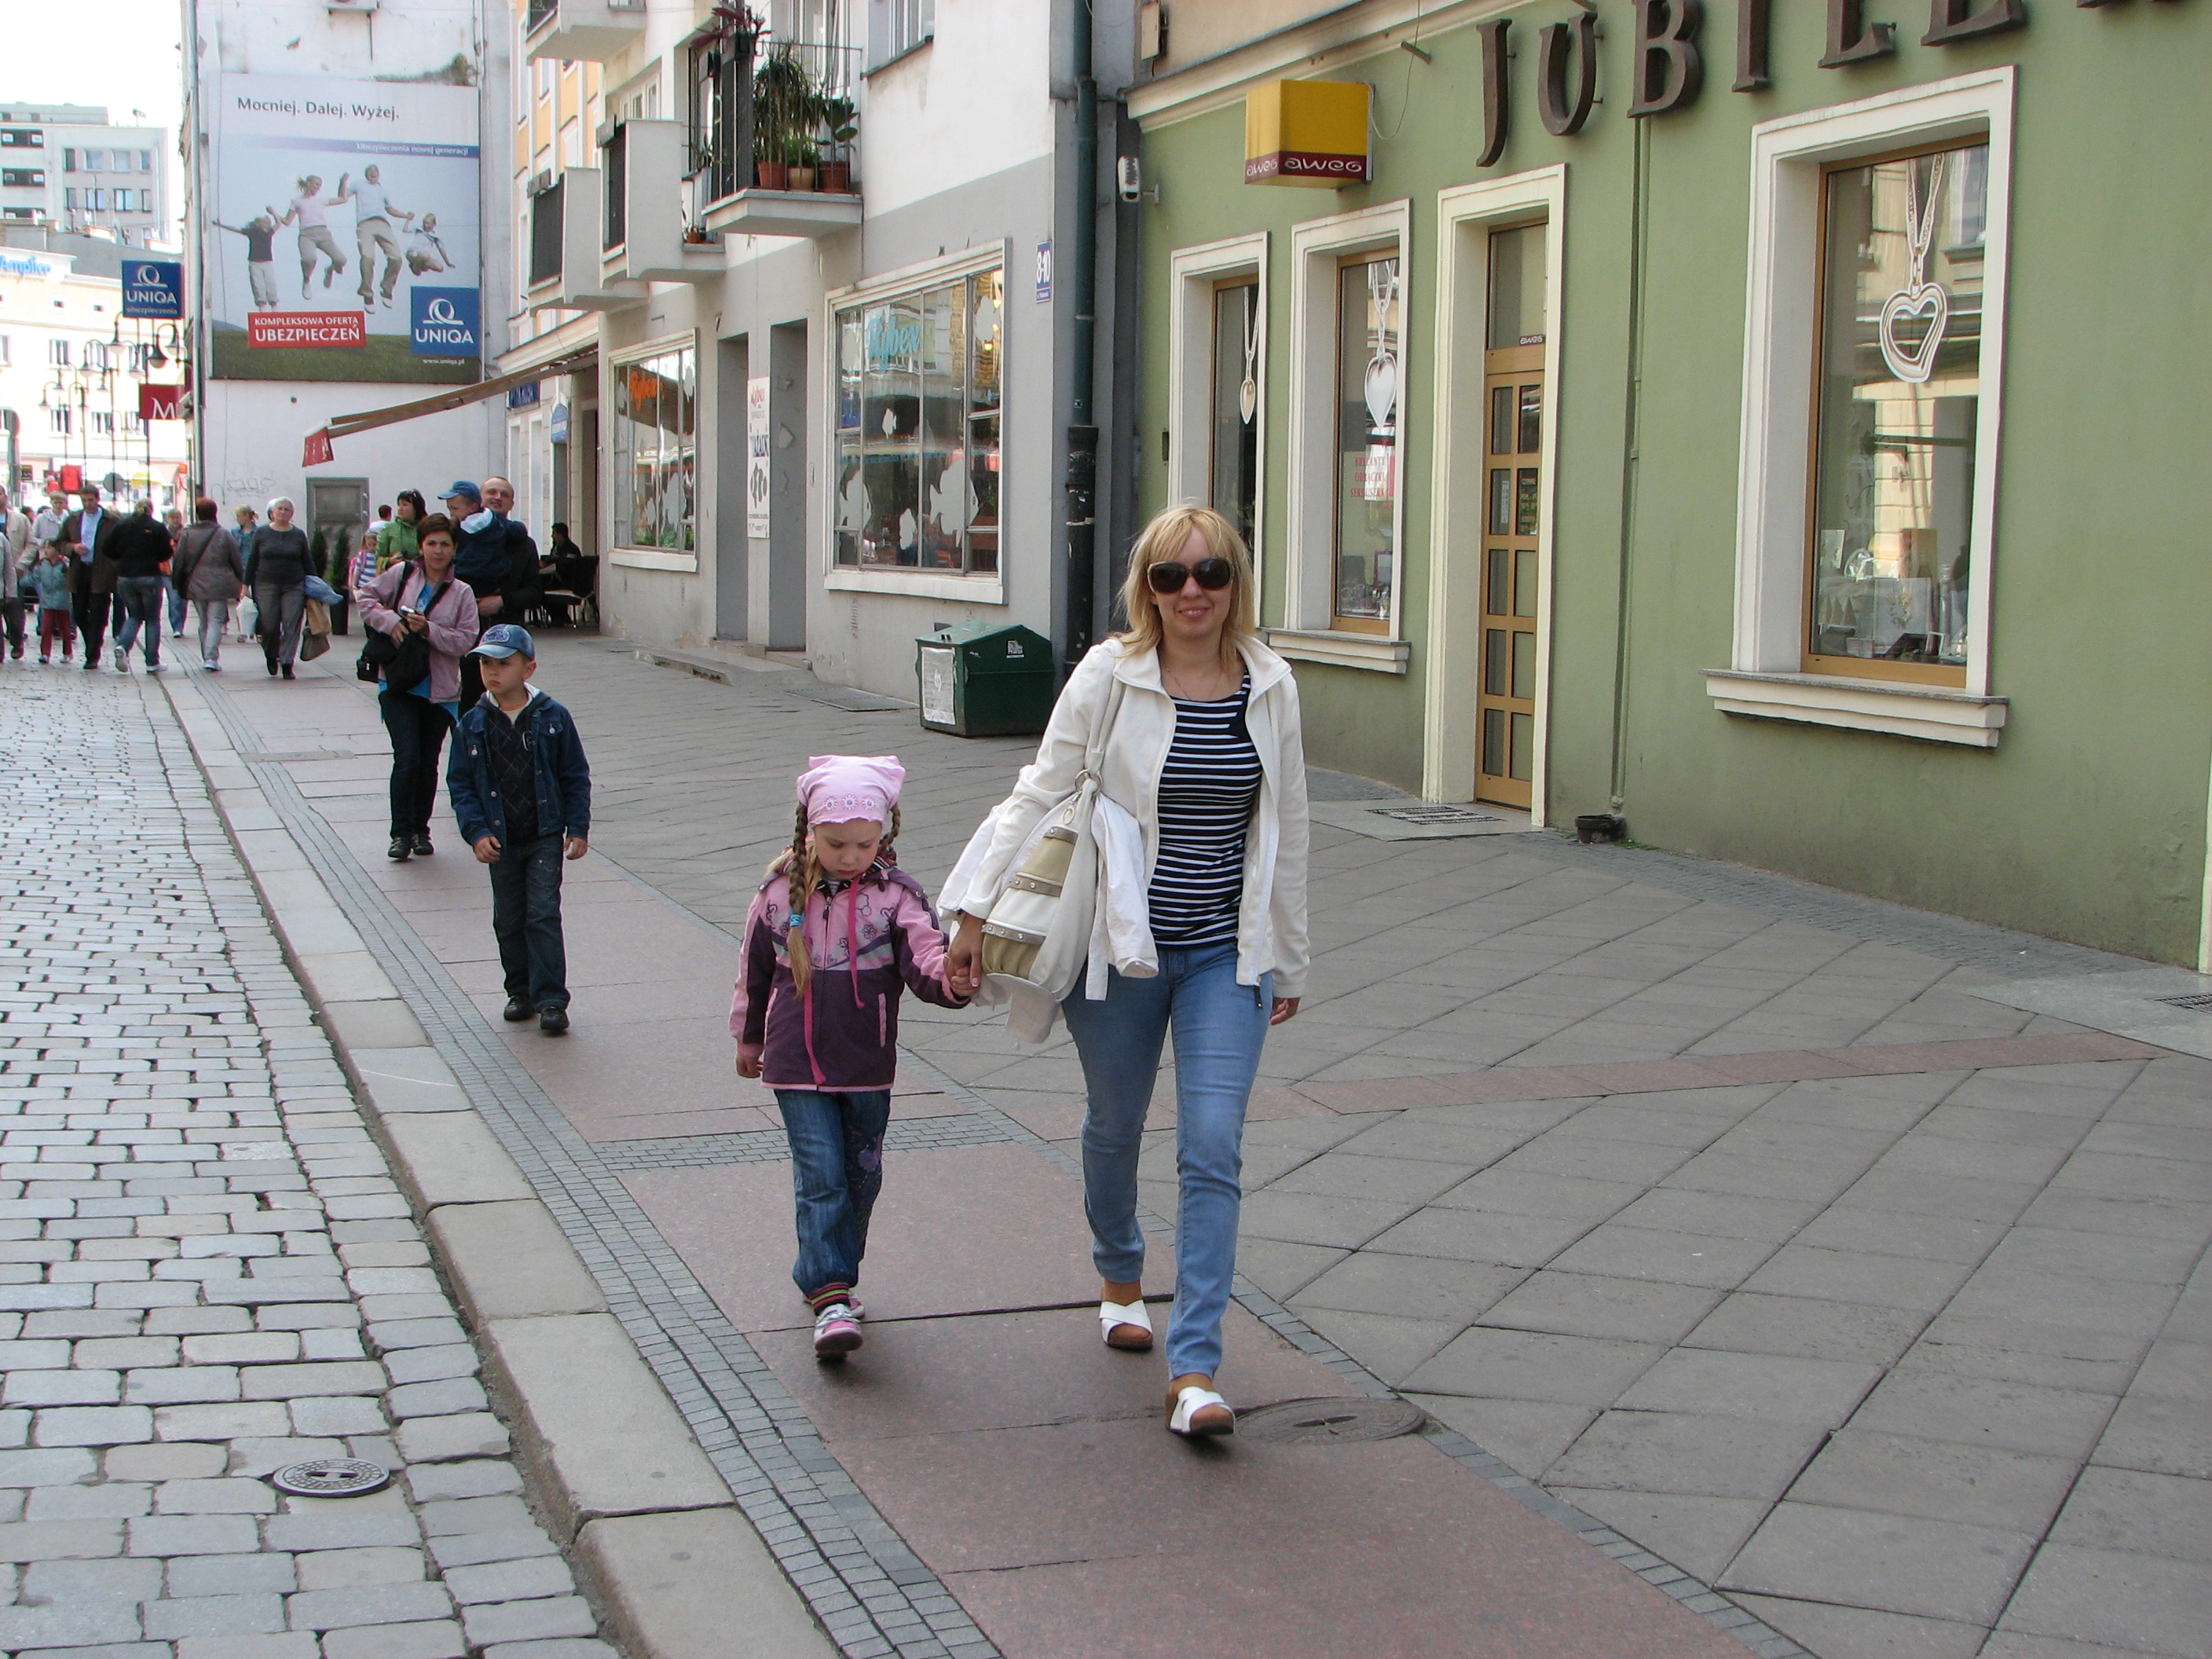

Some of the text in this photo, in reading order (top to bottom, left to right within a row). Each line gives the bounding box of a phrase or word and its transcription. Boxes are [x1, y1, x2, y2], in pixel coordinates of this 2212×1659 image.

[237, 96, 400, 121] Mocniej. Dalej. Wyżej.
[357, 142, 469, 156] Ubezpieczenia nowej generacji
[1036, 249, 1051, 284] 8-10
[126, 291, 177, 304] UNIQA
[126, 306, 178, 315] ubezpieczenia
[255, 317, 359, 326] KOMPLEKSOWA OFERTA
[255, 324, 361, 342] UBEZPIECZEŃ
[416, 328, 474, 344] UNIQA
